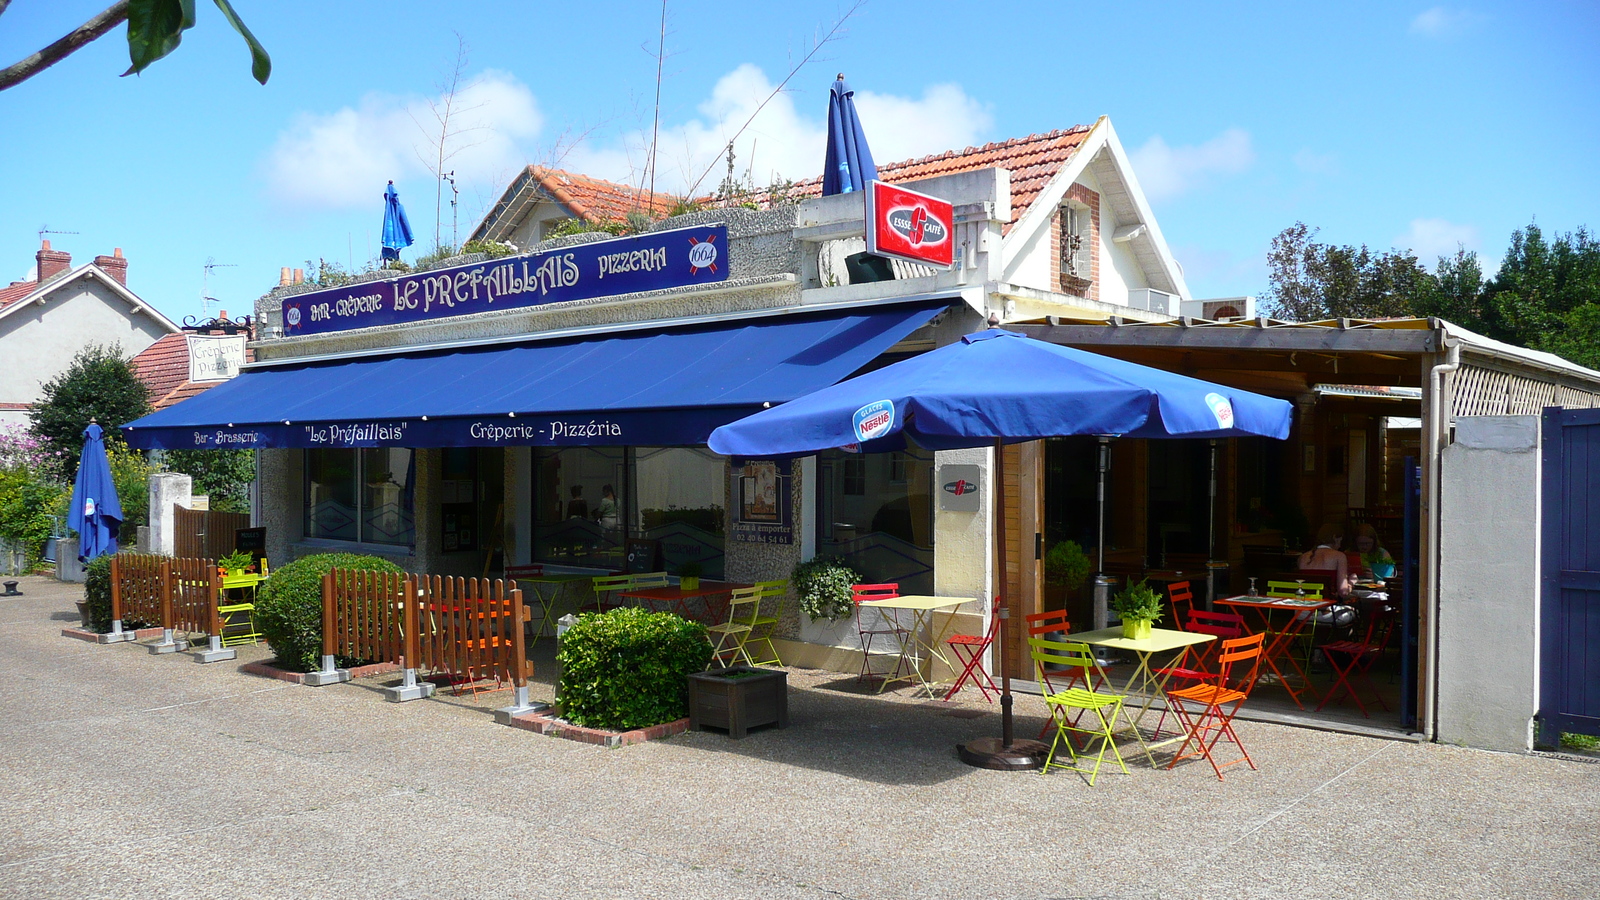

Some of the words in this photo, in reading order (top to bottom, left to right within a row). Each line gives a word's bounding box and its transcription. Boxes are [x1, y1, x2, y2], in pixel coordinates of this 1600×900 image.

[893, 217, 912, 230] ESSSE
[691, 245, 716, 263] 1664
[393, 280, 419, 312] LE
[422, 253, 580, 313] PREFAILLAIS
[597, 246, 667, 279] PIZZERIA
[194, 343, 240, 359] Crêperie
[215, 430, 258, 445] Brasserie
[470, 422, 534, 442] Crêperie
[549, 420, 622, 441] Pizzéria
[732, 522, 750, 532] Pizza
[758, 524, 791, 534] emporter
[736, 533, 746, 541] 02
[747, 534, 756, 542] 40
[757, 534, 767, 544] 64
[768, 536, 778, 544] 54
[779, 536, 788, 544] 61
